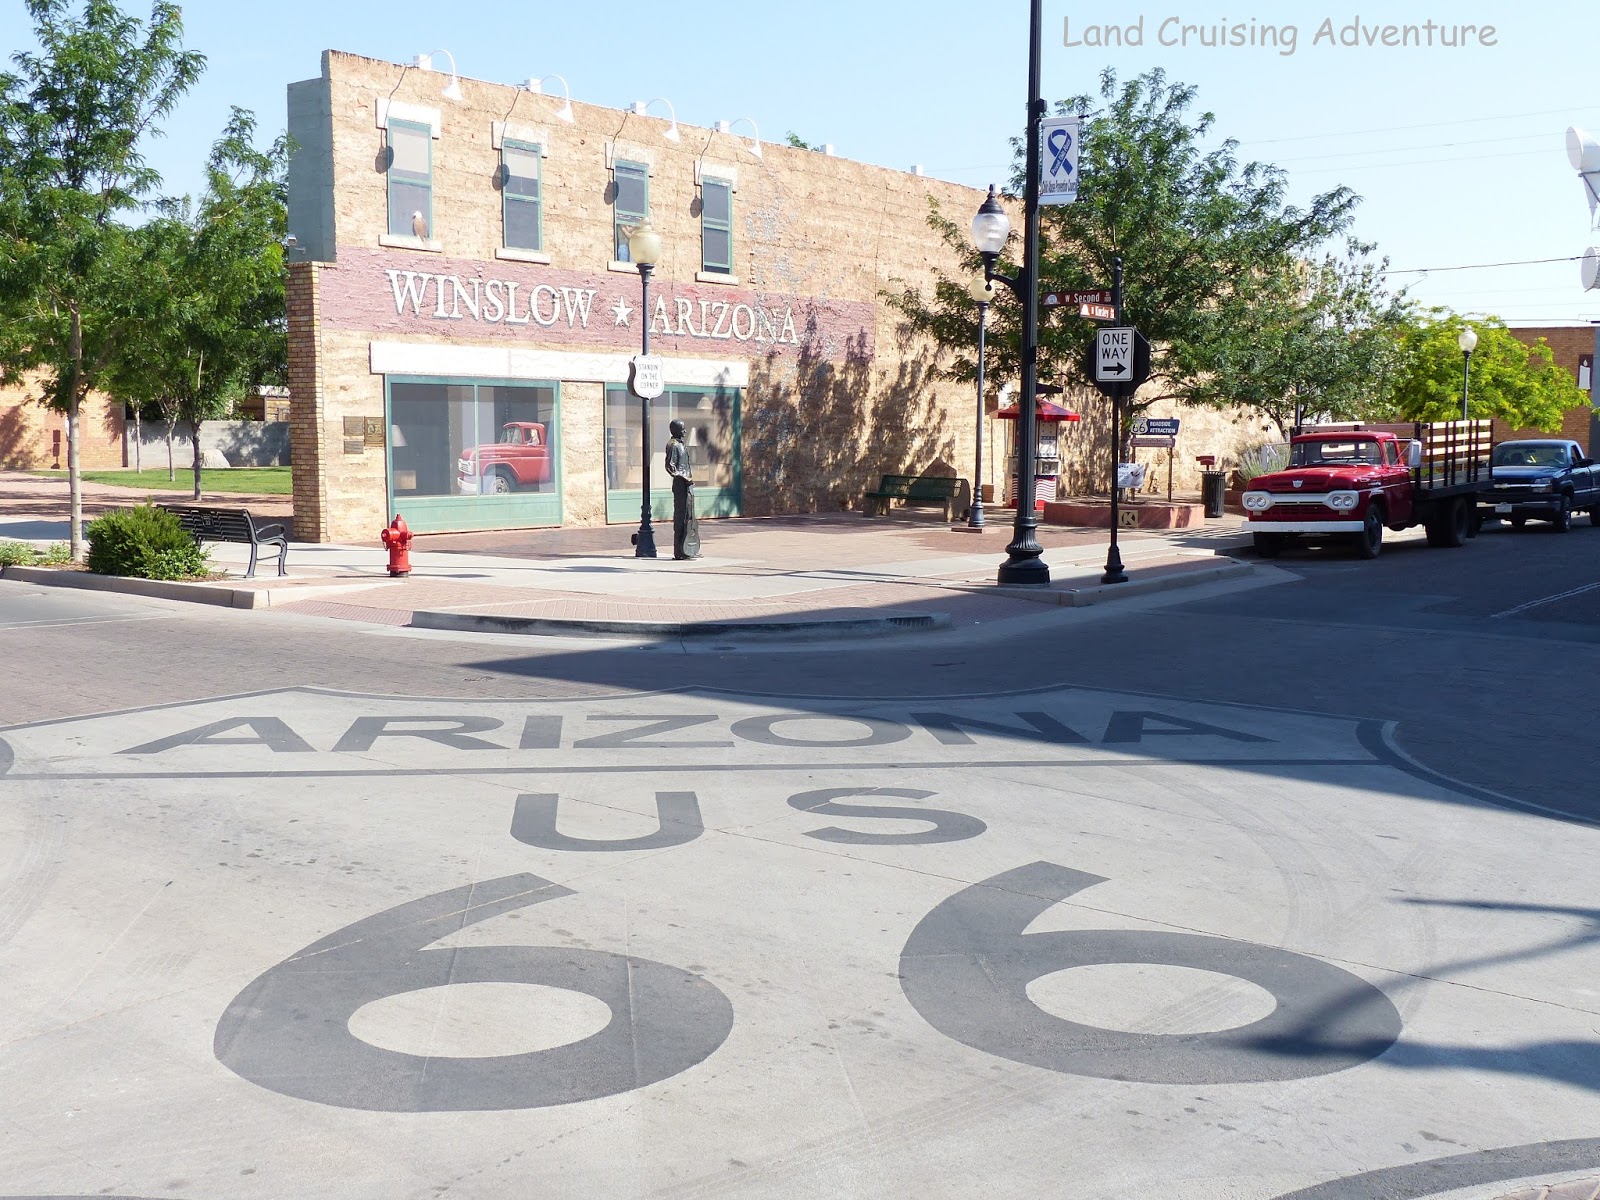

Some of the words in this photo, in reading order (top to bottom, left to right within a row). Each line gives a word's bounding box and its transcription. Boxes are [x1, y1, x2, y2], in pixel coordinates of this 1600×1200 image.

[385, 269, 598, 329] WINSLOW
[649, 294, 800, 345] ARIZONA
[1065, 294, 1071, 303] W
[1073, 292, 1100, 303] Second
[1102, 333, 1128, 345] ONE
[1101, 347, 1128, 360] WAY
[1132, 423, 1146, 433] 66
[112, 710, 1278, 754] ARIZONA
[510, 786, 988, 853] US
[213, 860, 1402, 1112] 66
